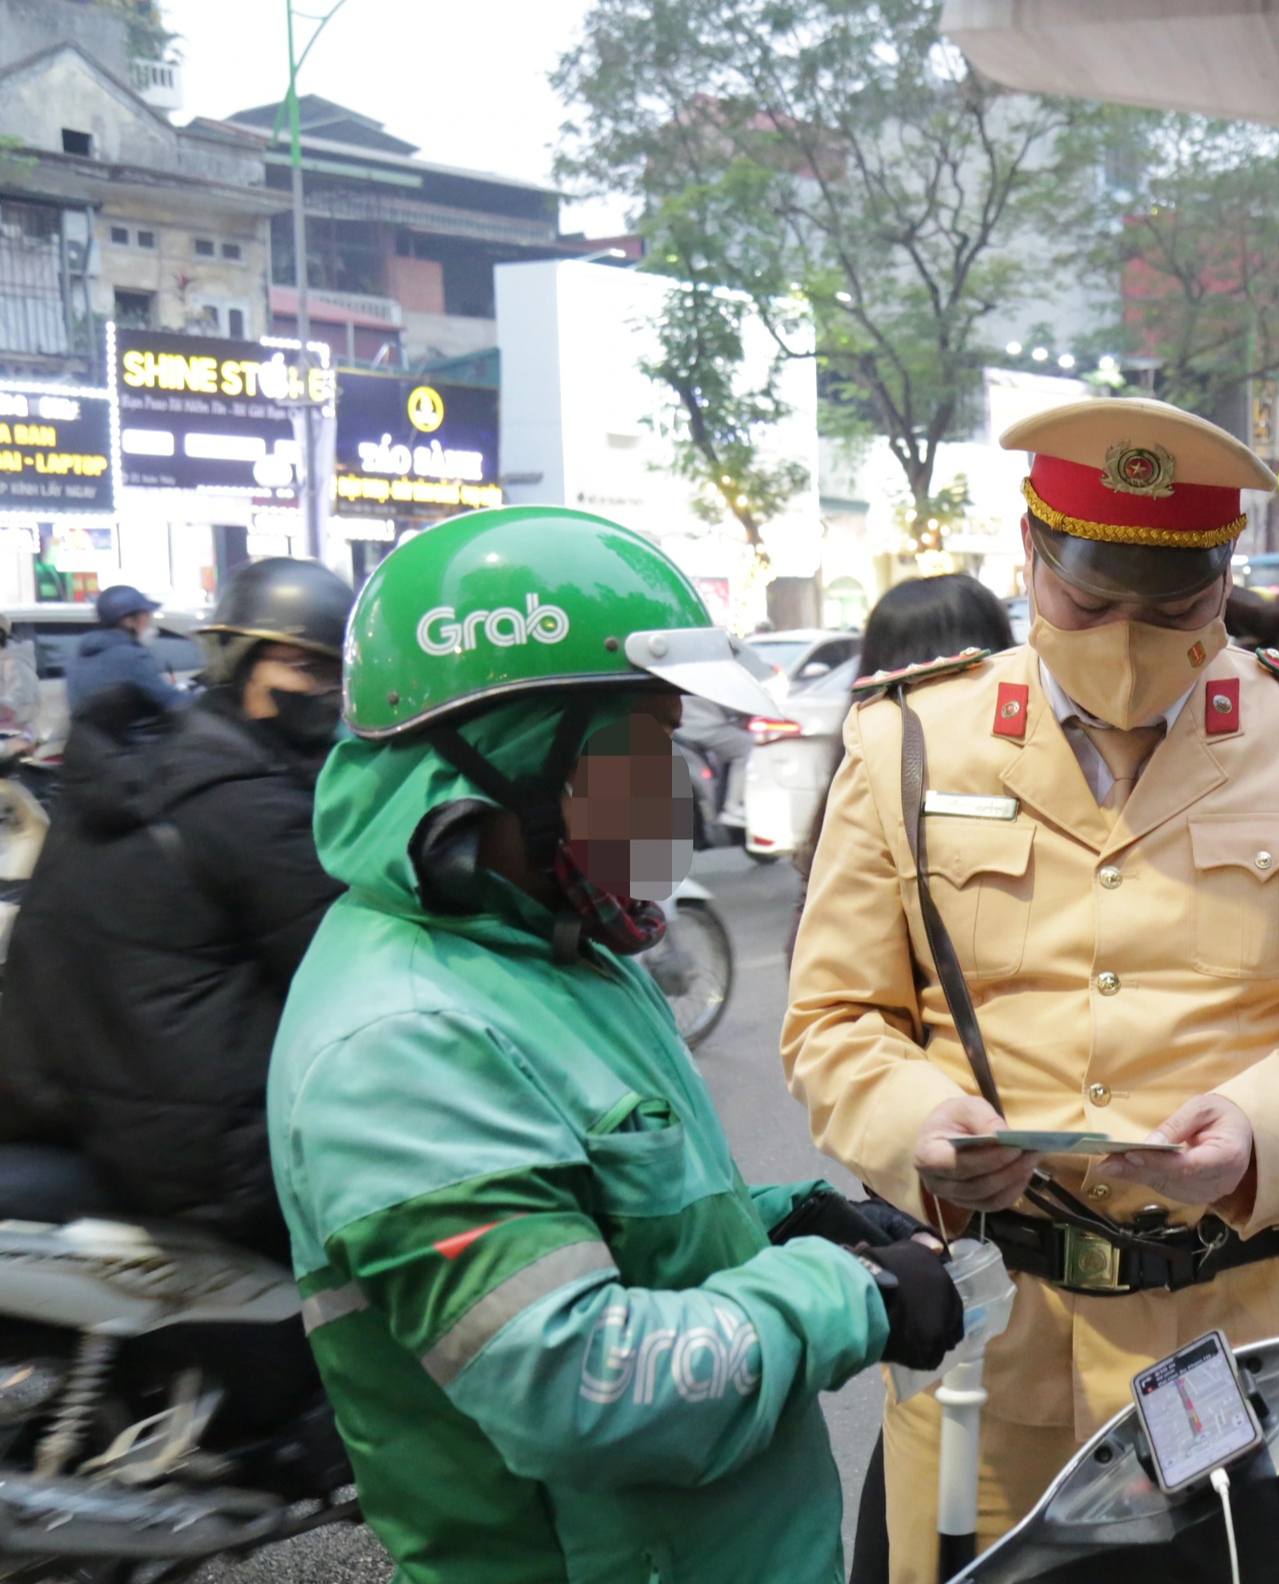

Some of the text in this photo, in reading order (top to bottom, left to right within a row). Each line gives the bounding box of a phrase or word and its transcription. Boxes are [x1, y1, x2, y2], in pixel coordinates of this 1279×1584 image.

[123, 350, 217, 393] SHINE
[35, 453, 108, 476] LAPTOP
[416, 592, 570, 656] Grab
